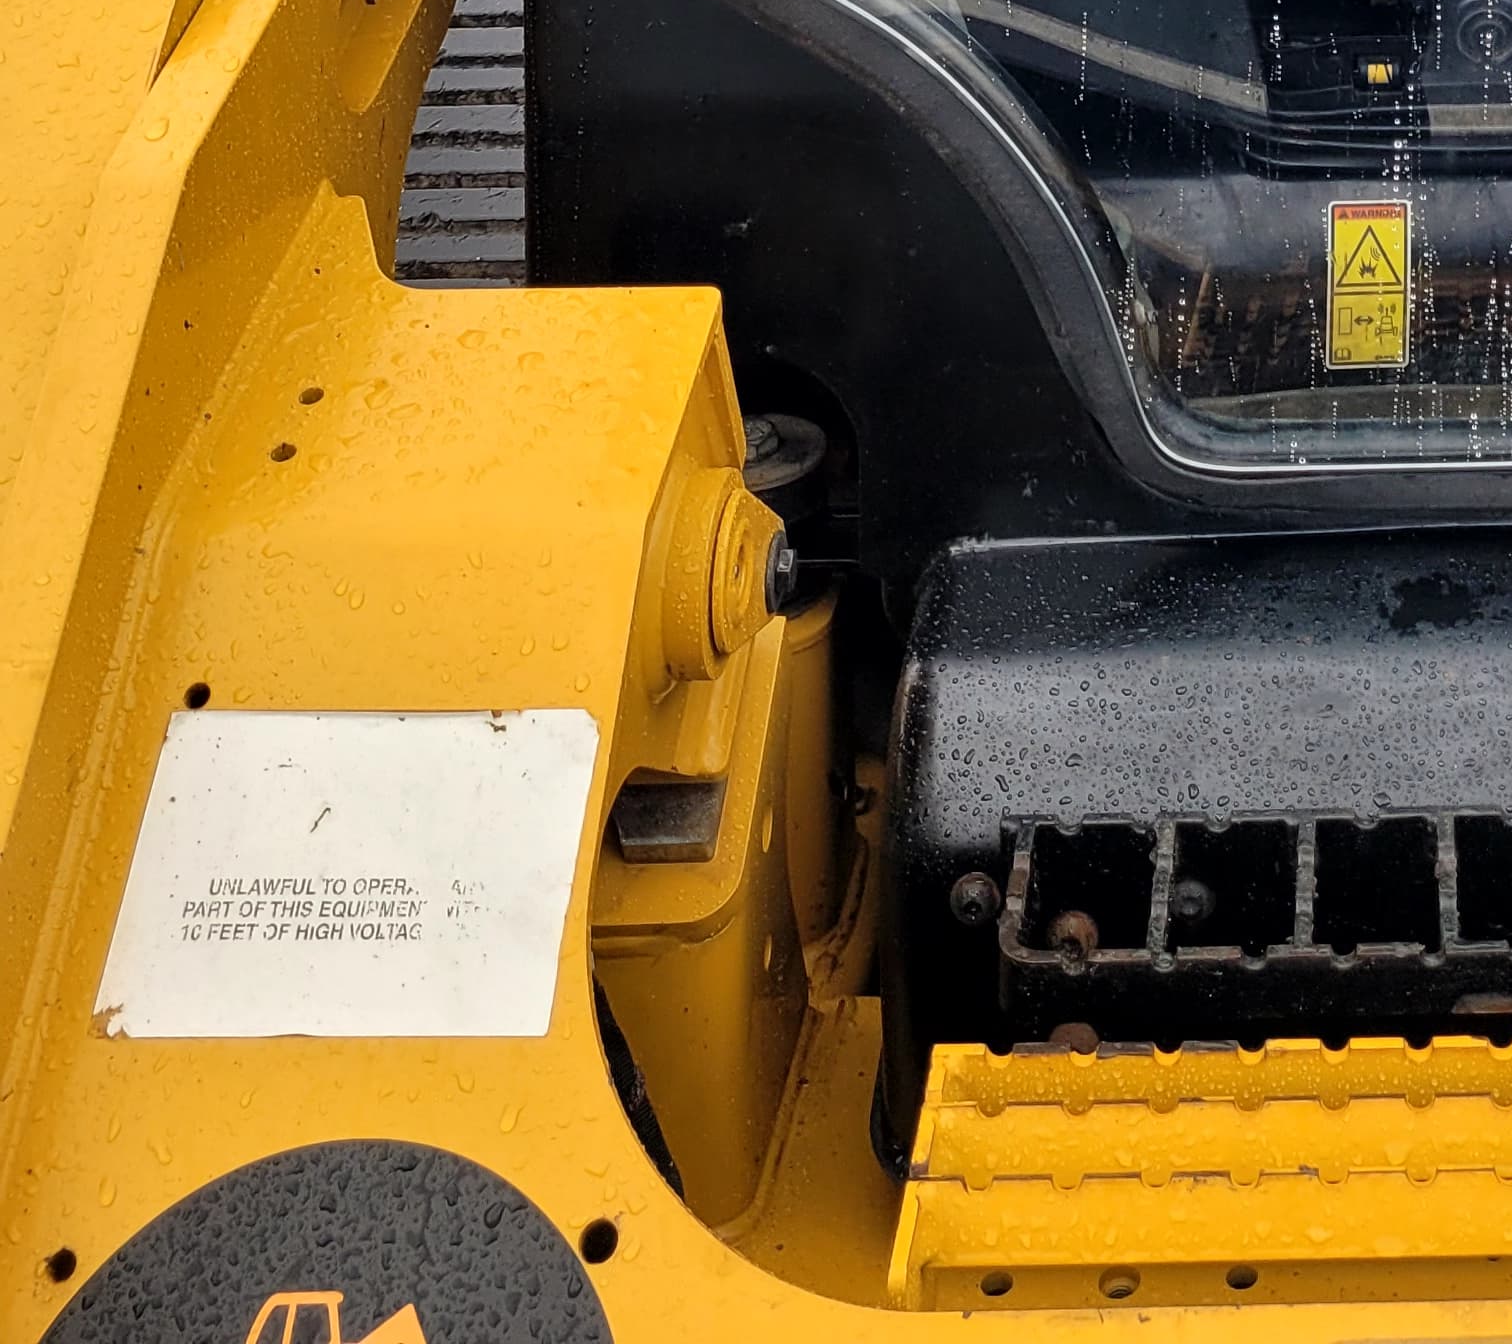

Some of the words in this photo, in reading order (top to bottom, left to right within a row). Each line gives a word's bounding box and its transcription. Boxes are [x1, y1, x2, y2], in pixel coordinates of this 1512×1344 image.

[1350, 209, 1401, 218] WARNING
[209, 878, 316, 895] UNLAWFUL
[322, 878, 347, 895] TO
[182, 900, 234, 918] PART
[239, 900, 267, 918] OF
[271, 900, 314, 918] THIS
[319, 900, 428, 918] EQUIPMEN
[207, 923, 259, 941] FEET
[263, 923, 291, 941] OF
[295, 923, 344, 941] HIGH
